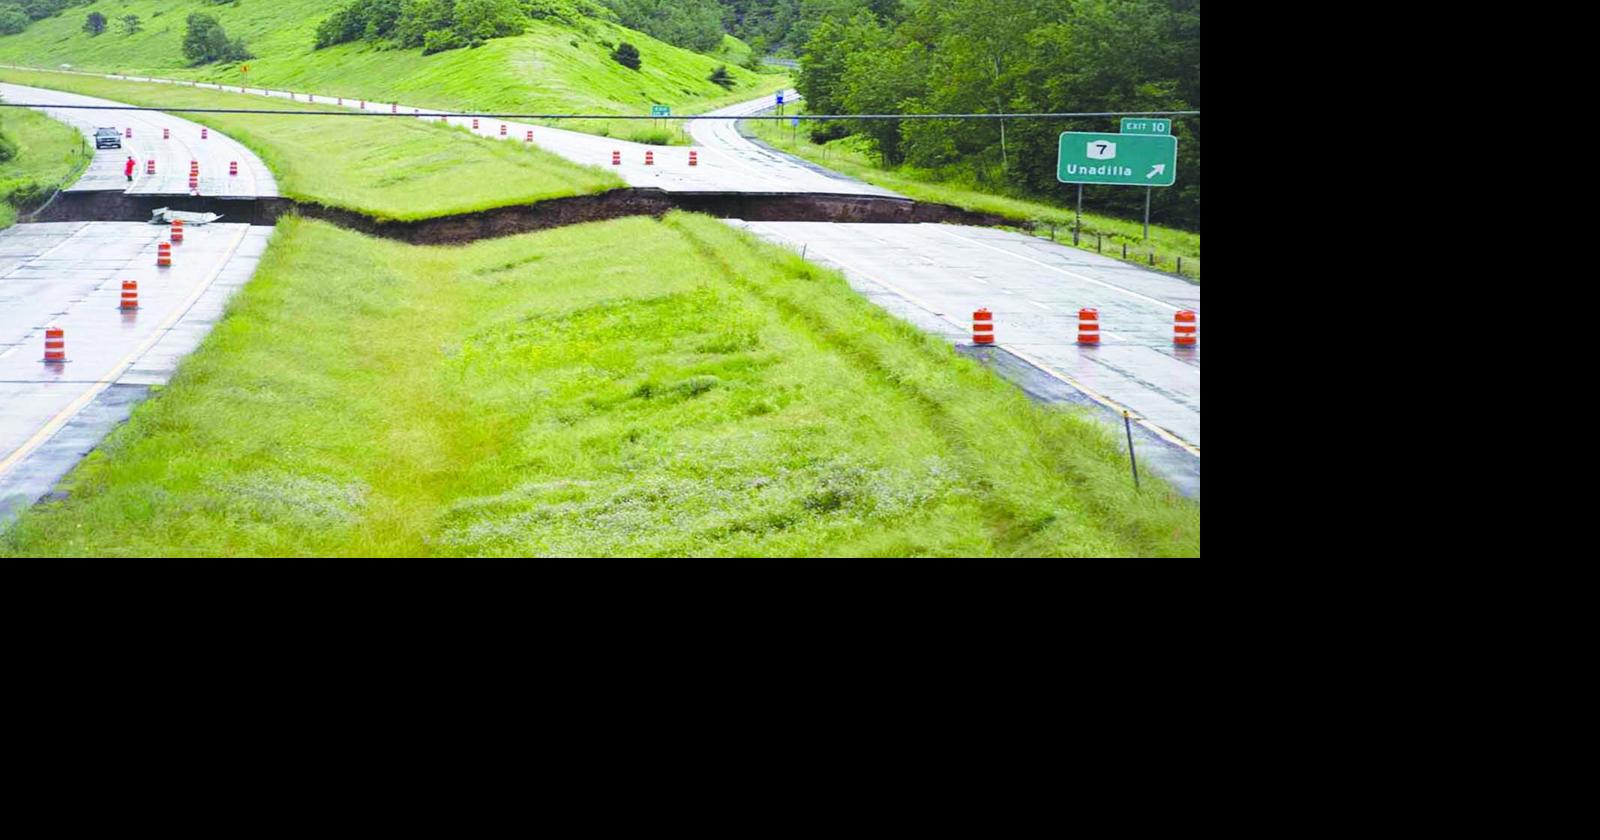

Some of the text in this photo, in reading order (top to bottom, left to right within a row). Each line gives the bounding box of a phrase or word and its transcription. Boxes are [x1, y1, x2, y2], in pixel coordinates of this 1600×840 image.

[1152, 122, 1165, 132] 10
[1096, 144, 1107, 155] 7
[1067, 164, 1132, 176] Unadilla
